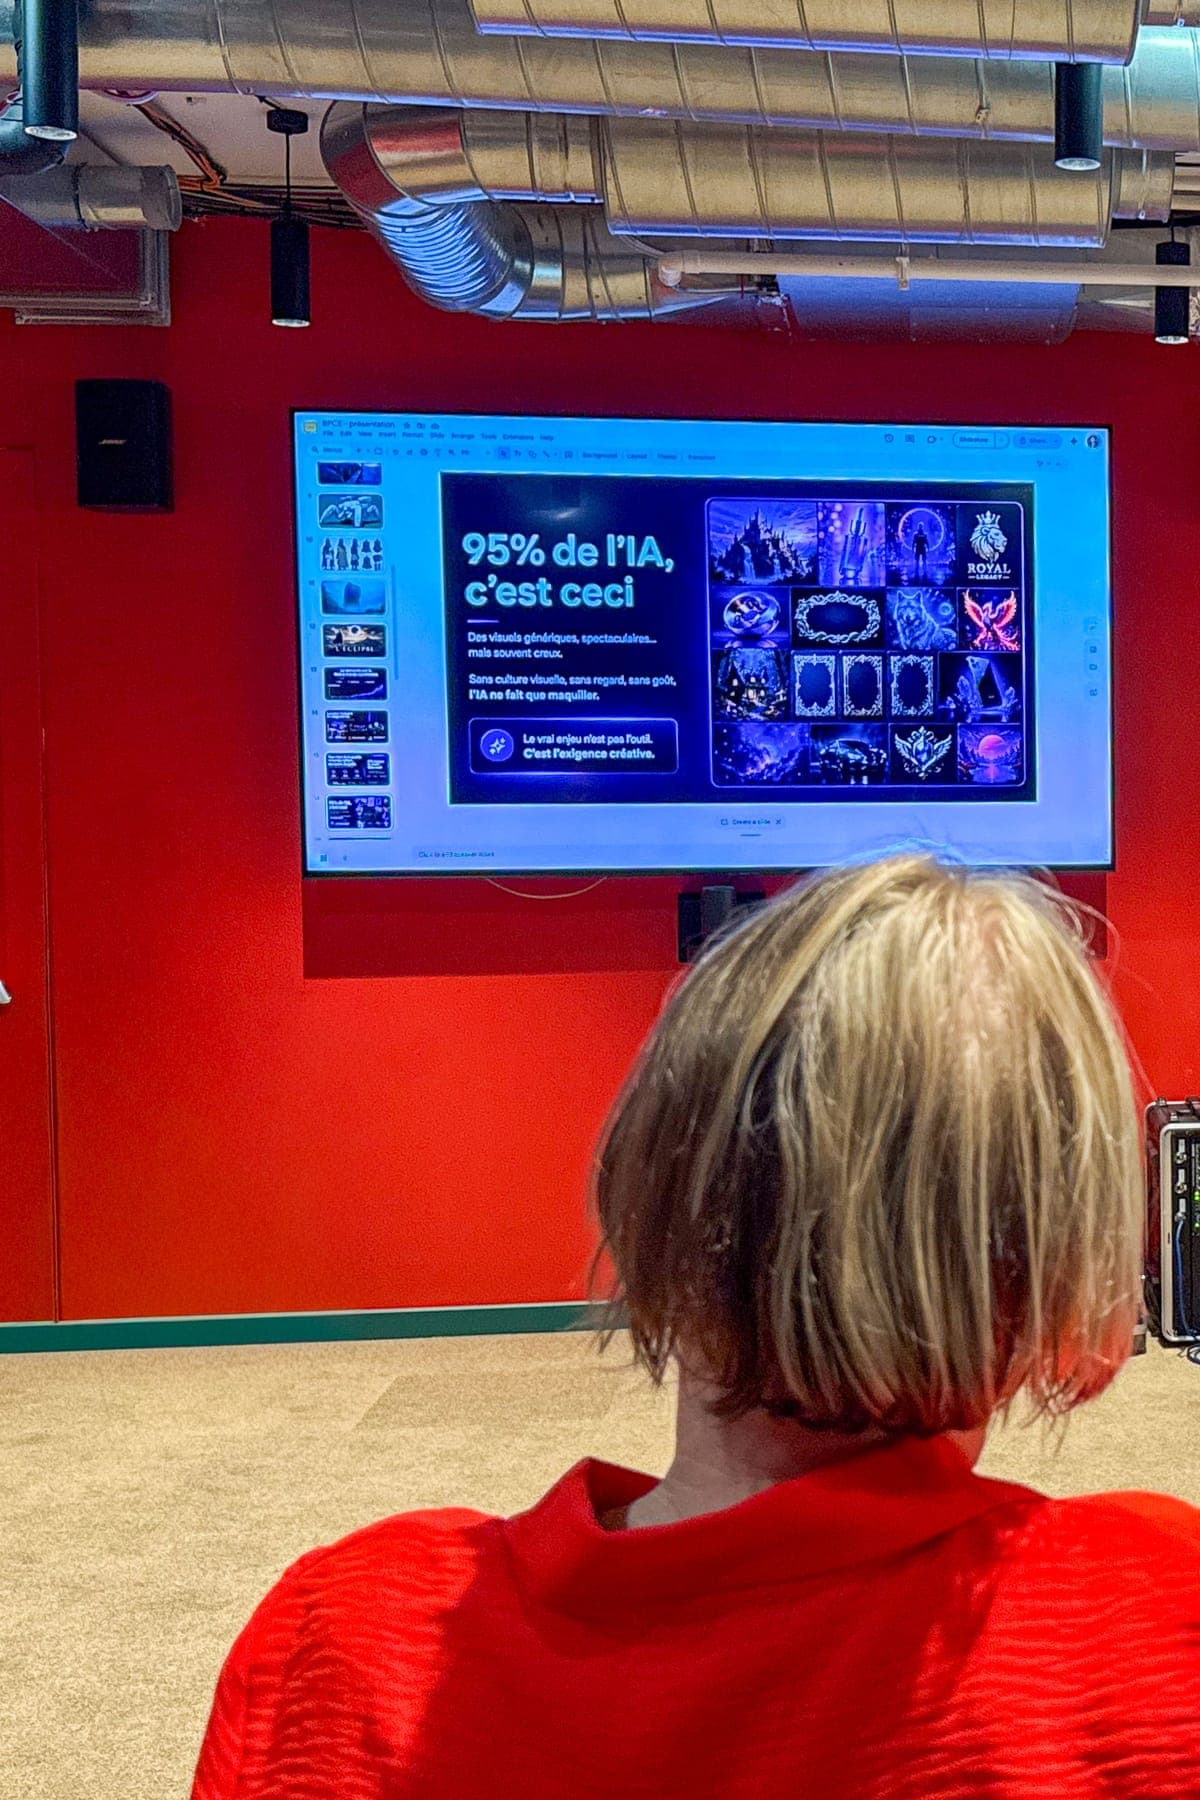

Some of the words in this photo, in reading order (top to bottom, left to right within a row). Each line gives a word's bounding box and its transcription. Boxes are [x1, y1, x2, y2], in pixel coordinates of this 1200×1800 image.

[462, 532, 546, 566] 95%
[552, 533, 599, 567] de
[606, 533, 675, 573] l'IA,
[967, 563, 1012, 574] ROYAL
[464, 574, 553, 607] c'est
[560, 575, 635, 608] ceci
[467, 632, 488, 643] Des
[489, 632, 523, 643] visuels
[524, 632, 580, 645] génériques,
[468, 648, 492, 658] mais
[493, 648, 532, 658] souvent
[468, 674, 494, 685] Sans
[495, 674, 528, 685] culture
[530, 674, 568, 686] visuelle,
[569, 676, 592, 685] sans
[593, 675, 627, 687] regard,
[628, 676, 651, 686] sans
[490, 691, 503, 700] ne
[505, 690, 524, 700] fait
[525, 691, 546, 702] que
[547, 689, 600, 702] maquiller.
[523, 733, 536, 743] Le
[537, 733, 554, 744] vrai
[556, 734, 582, 746] enjeu
[583, 733, 606, 744] n'est
[607, 735, 625, 746] pas
[523, 748, 552, 759] C'est
[553, 748, 608, 762] l'exigence
[609, 748, 655, 759] créative.
